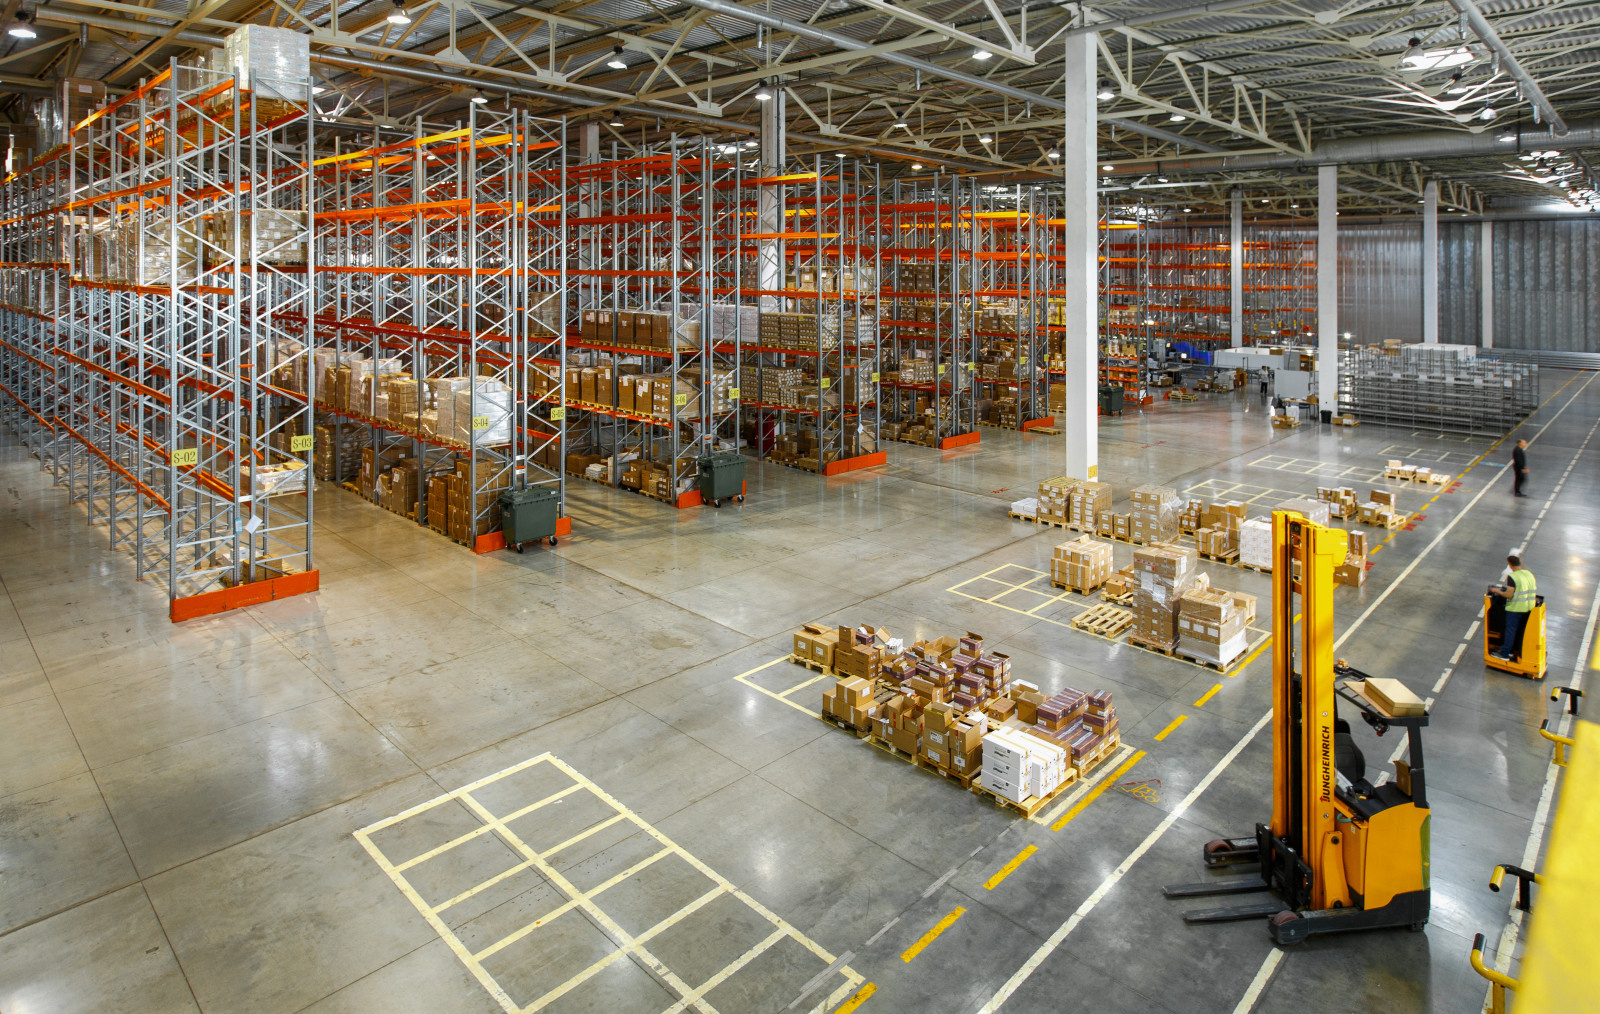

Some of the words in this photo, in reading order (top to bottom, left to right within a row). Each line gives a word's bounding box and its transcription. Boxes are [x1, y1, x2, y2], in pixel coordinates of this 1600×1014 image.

[474, 418, 488, 428] S-04
[292, 437, 312, 449] S-03
[173, 451, 196, 464] S-02
[1322, 726, 1330, 802] JUNGHEINRICH
